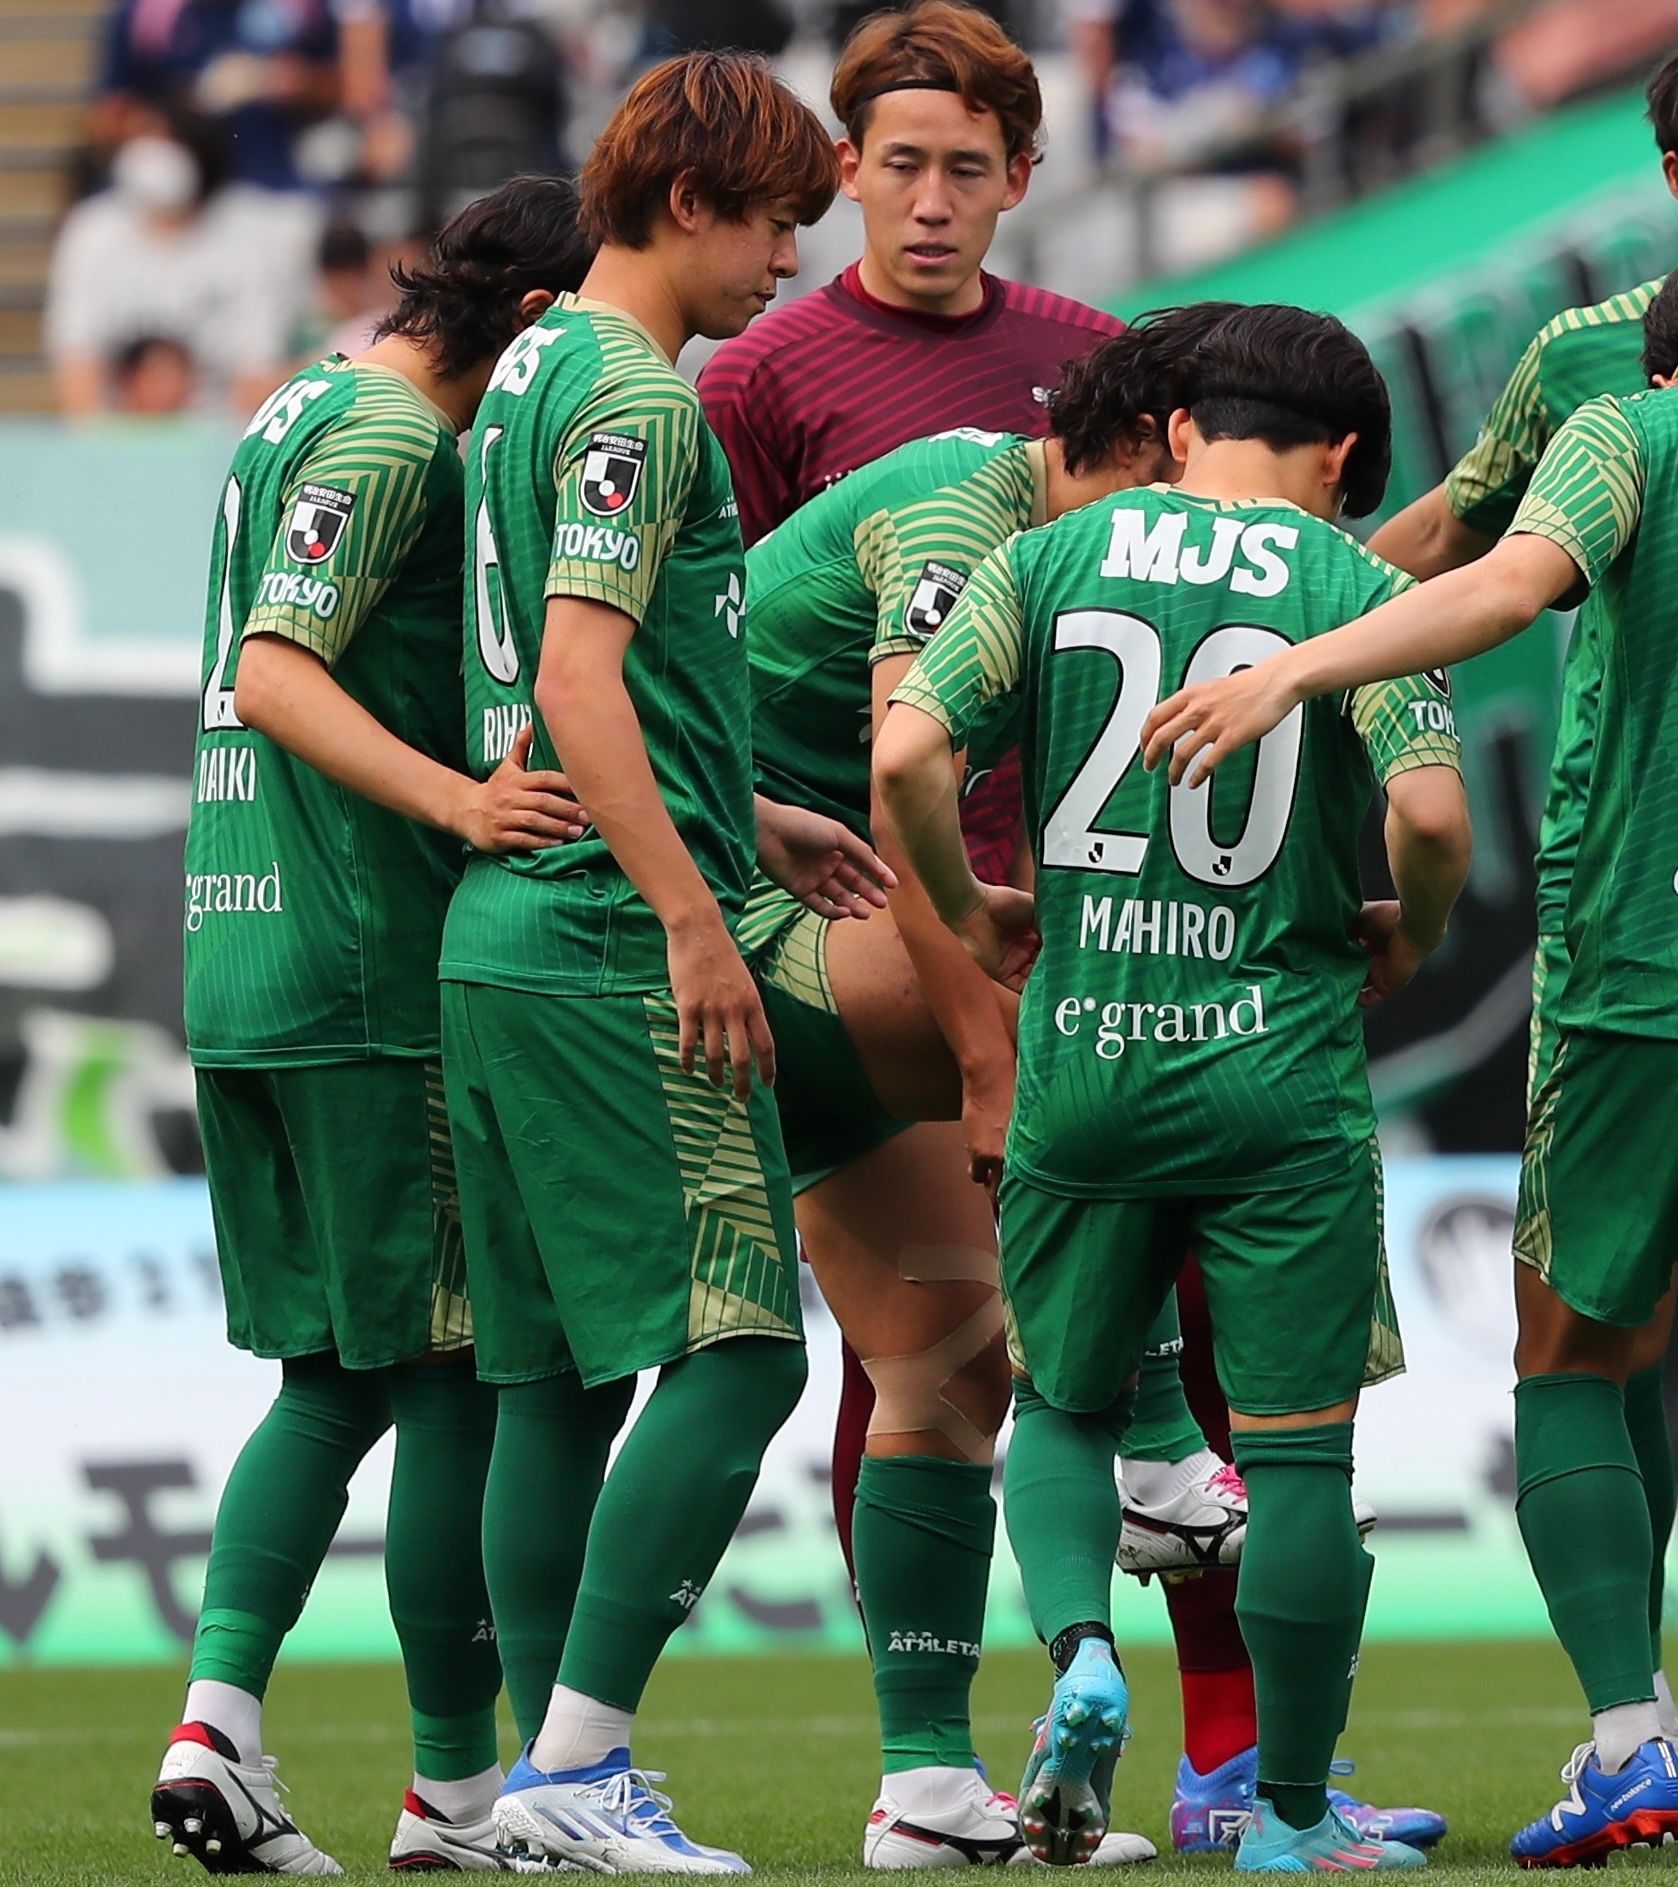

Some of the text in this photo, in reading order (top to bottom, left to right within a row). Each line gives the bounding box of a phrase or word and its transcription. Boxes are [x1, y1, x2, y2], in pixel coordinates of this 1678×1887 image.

[555, 522, 640, 571] TOKYO
[1100, 508, 1299, 598] MJS
[257, 571, 339, 618] TOKYO
[198, 747, 256, 803] DAIKI
[1041, 606, 1305, 890] 20
[1079, 894, 1236, 961] MAHIRO
[887, 1638, 981, 1658] ATHLETA
